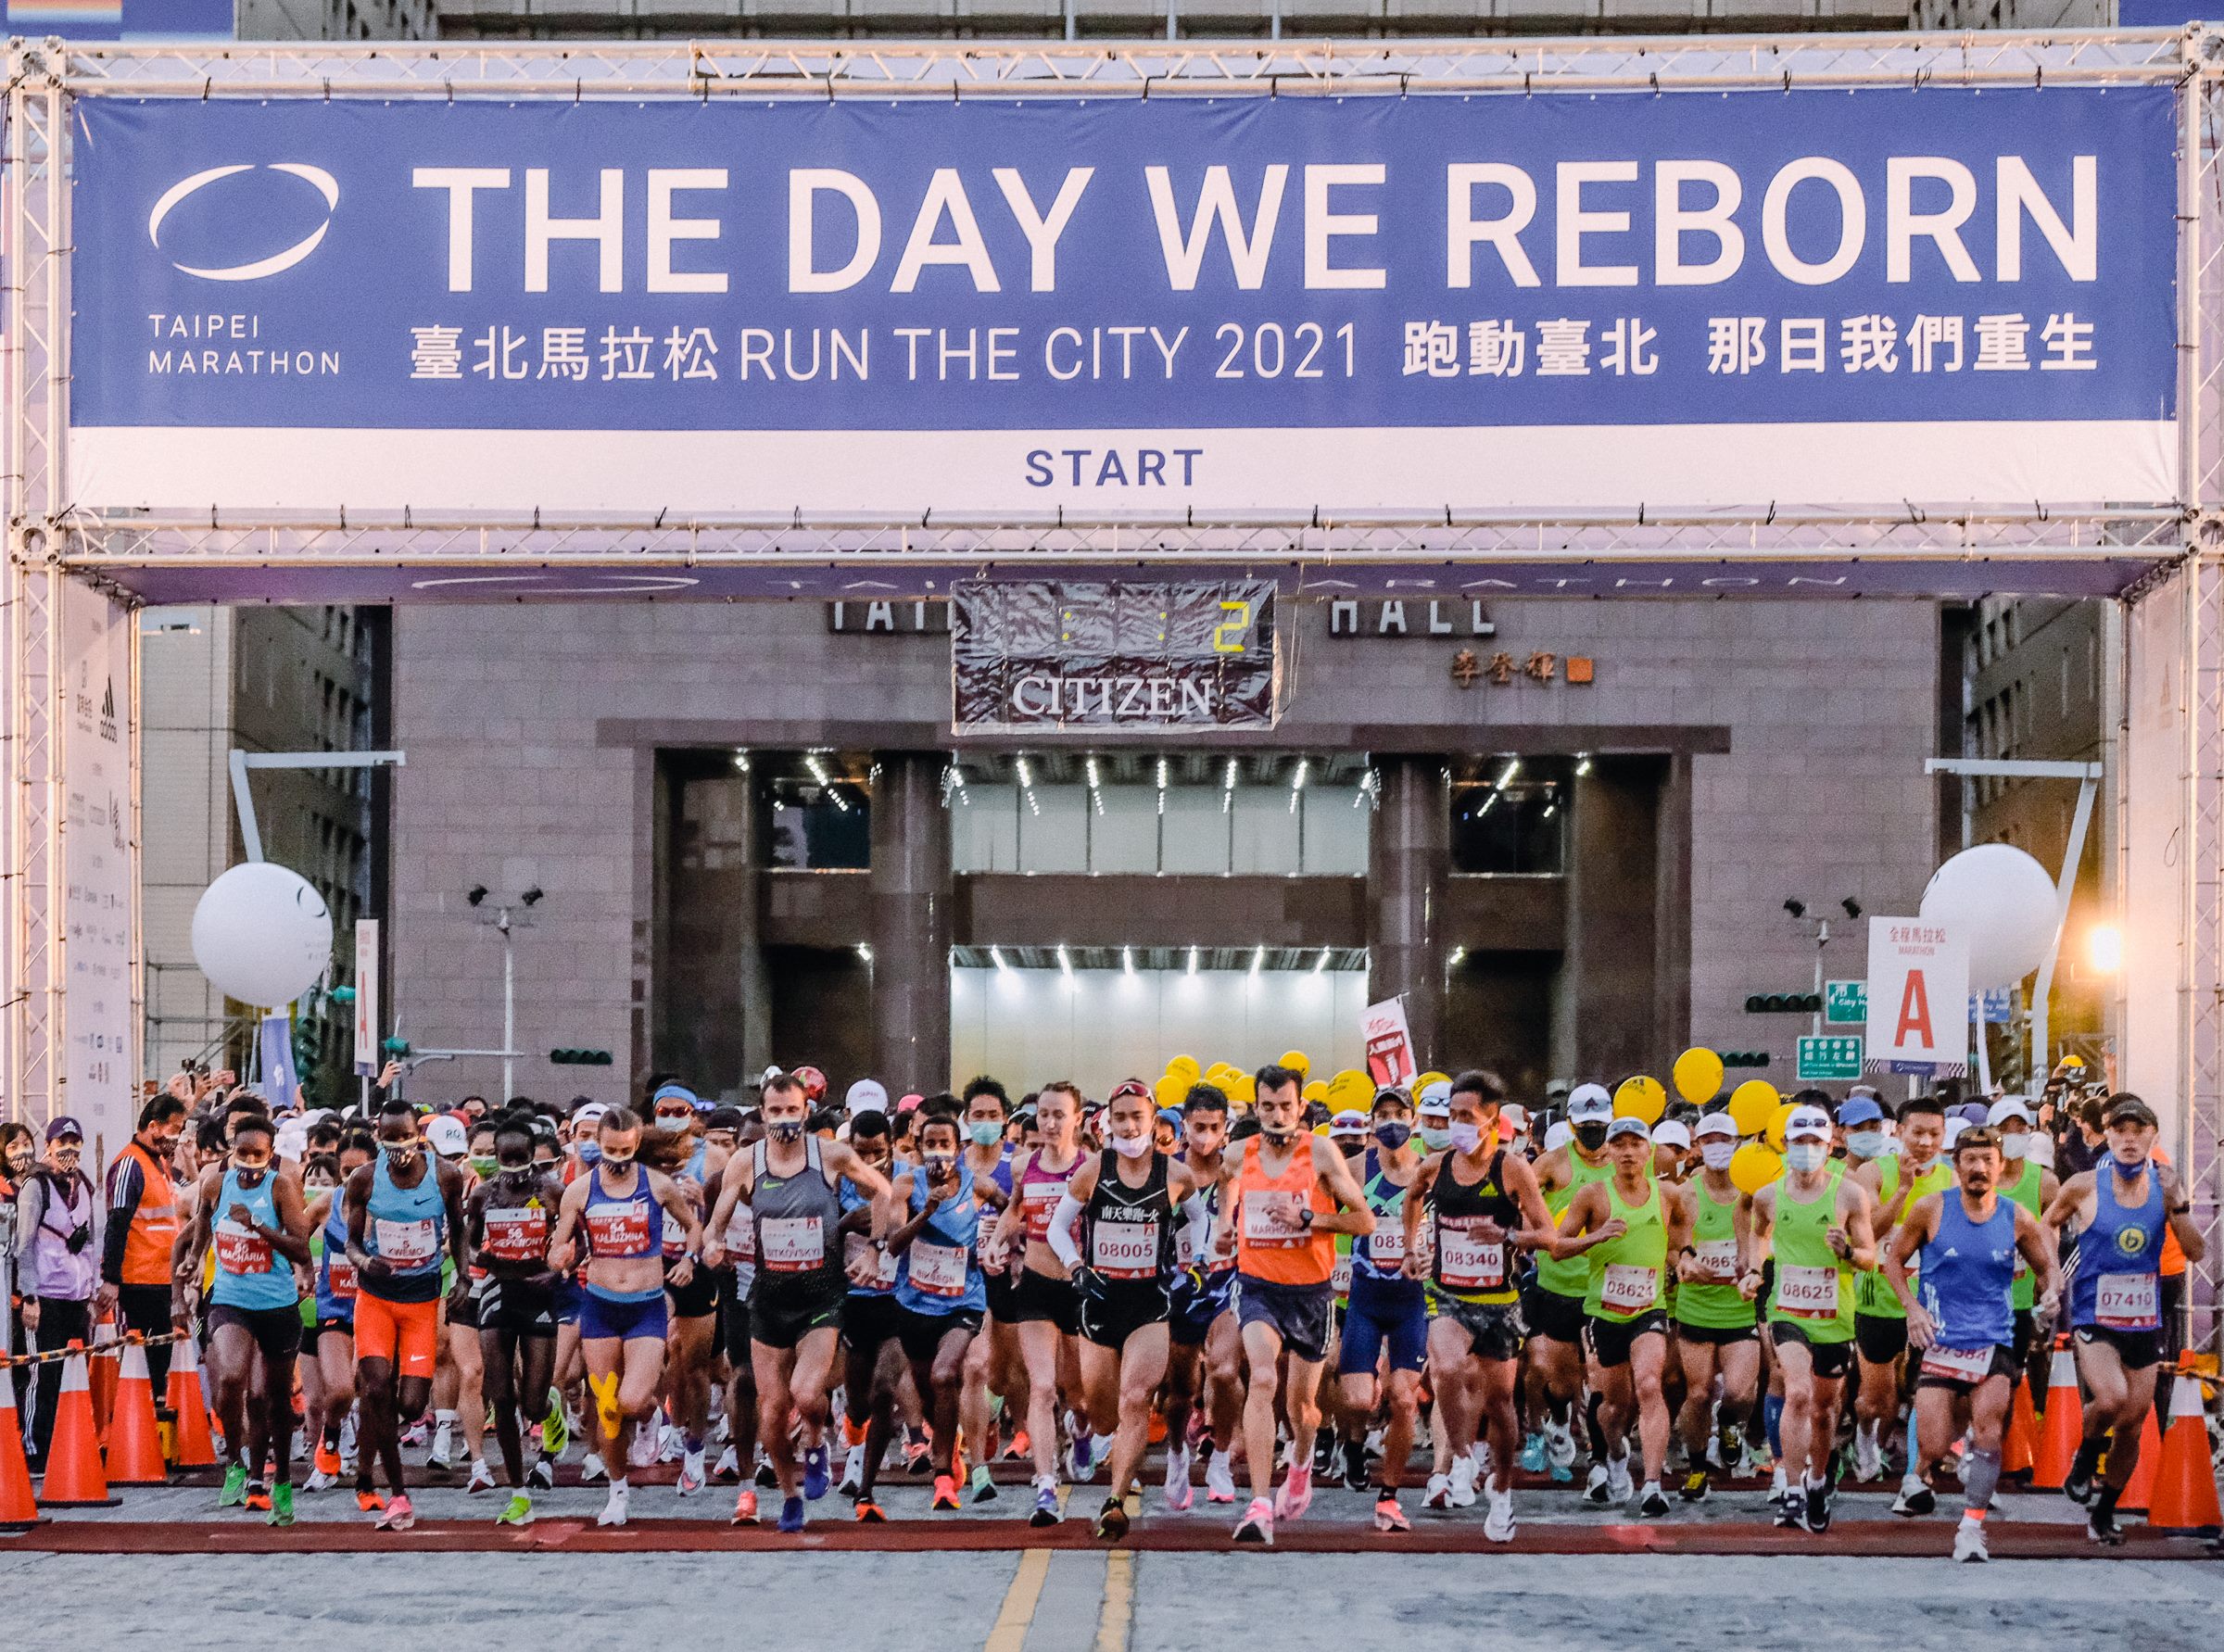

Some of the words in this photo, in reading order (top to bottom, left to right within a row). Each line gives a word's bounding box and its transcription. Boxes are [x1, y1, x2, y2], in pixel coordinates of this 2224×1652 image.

[412, 168, 728, 293] THE
[790, 168, 1094, 292] DAY
[1145, 164, 1386, 290] WE
[1447, 156, 2097, 287] REBORN
[148, 314, 259, 338] TAIPEI
[148, 350, 339, 374] MARATHON
[411, 324, 719, 381] 臺北馬拉松
[740, 328, 868, 381] RUN
[893, 327, 1020, 380] THE
[1044, 326, 1189, 380] CITY
[1215, 322, 1355, 378] 2021
[1403, 319, 1659, 378] 跑動臺北
[1708, 313, 2097, 374] 那日我們重生
[1025, 449, 1204, 487] START
[1012, 675, 1215, 716] CITIZEN
[1894, 969, 1935, 1049] A
[1098, 1242, 1154, 1258] 08005
[1445, 1251, 1498, 1267] 08340
[1782, 1282, 1834, 1300] 08625
